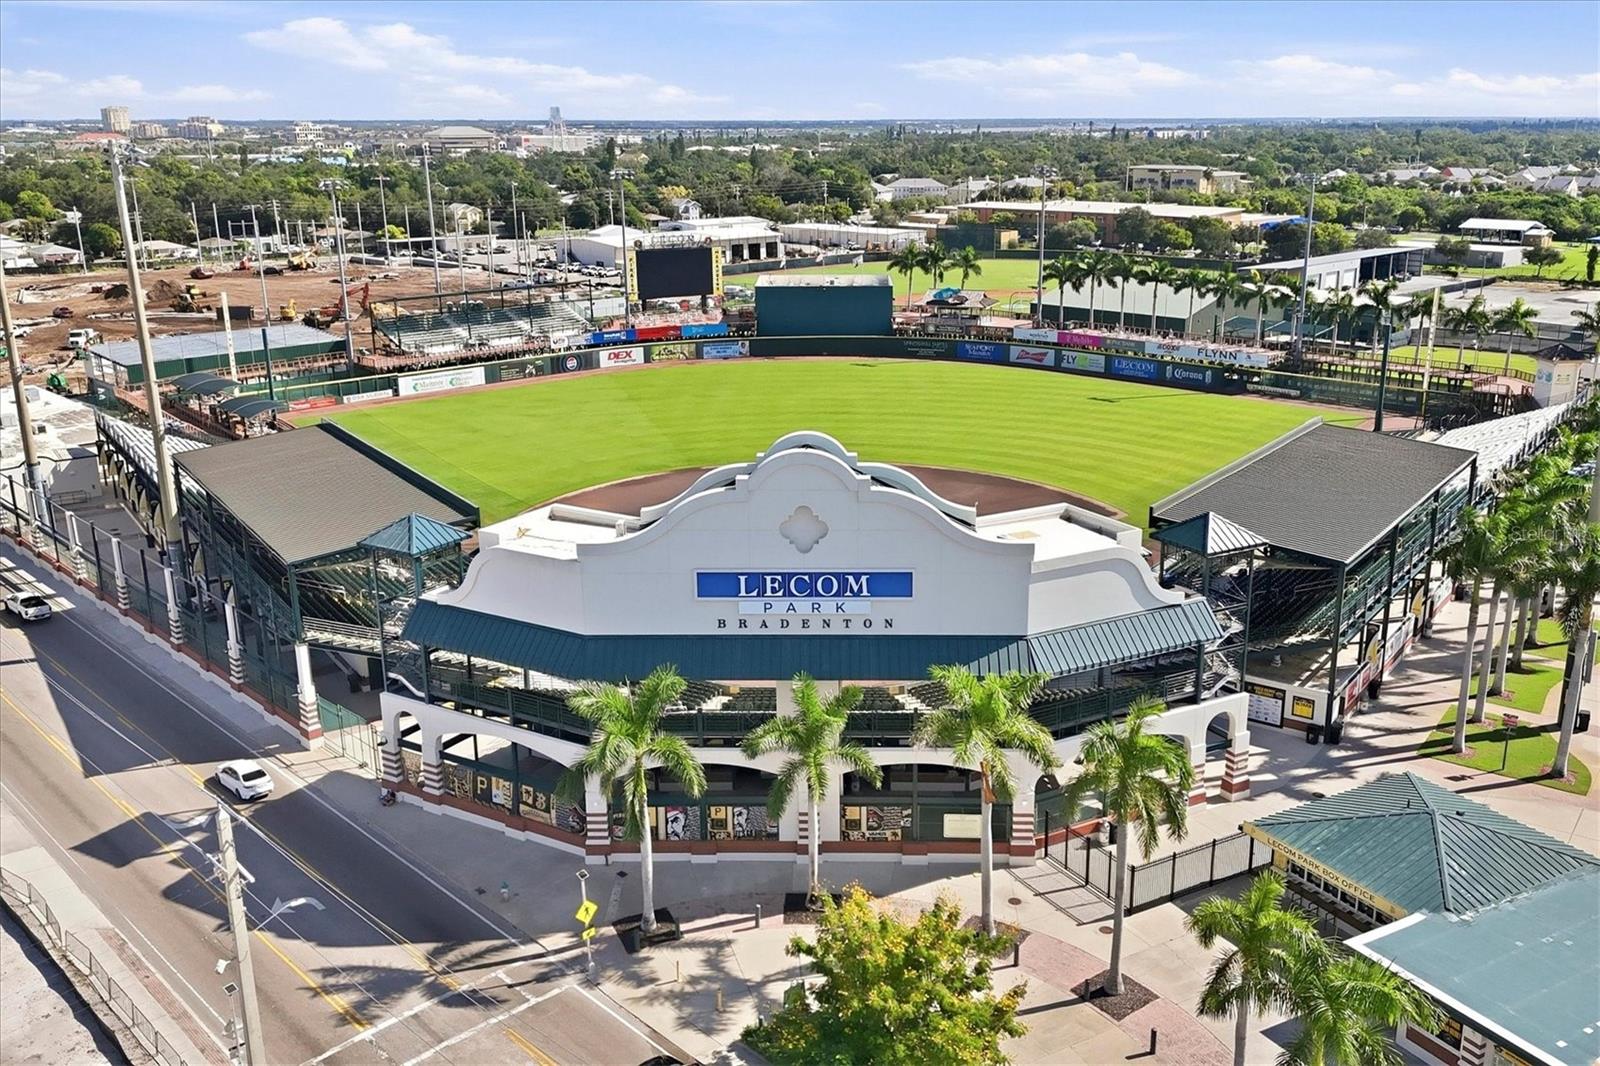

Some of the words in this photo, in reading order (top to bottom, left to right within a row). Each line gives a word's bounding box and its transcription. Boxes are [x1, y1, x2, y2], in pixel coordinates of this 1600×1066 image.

[607, 350, 633, 360] DEX
[1061, 354, 1077, 364] FLY
[1197, 349, 1238, 361] FLYNN
[1114, 358, 1154, 373] LECOM
[1174, 368, 1203, 381] Corona
[737, 574, 870, 597] LECOM
[763, 602, 846, 613] PARK
[717, 618, 894, 629] BRADENTON
[477, 775, 487, 794] P
[1267, 837, 1297, 859] LECOM
[1298, 854, 1321, 874] PARK
[1322, 867, 1341, 883] BOX
[1341, 880, 1376, 904] OFFICE
